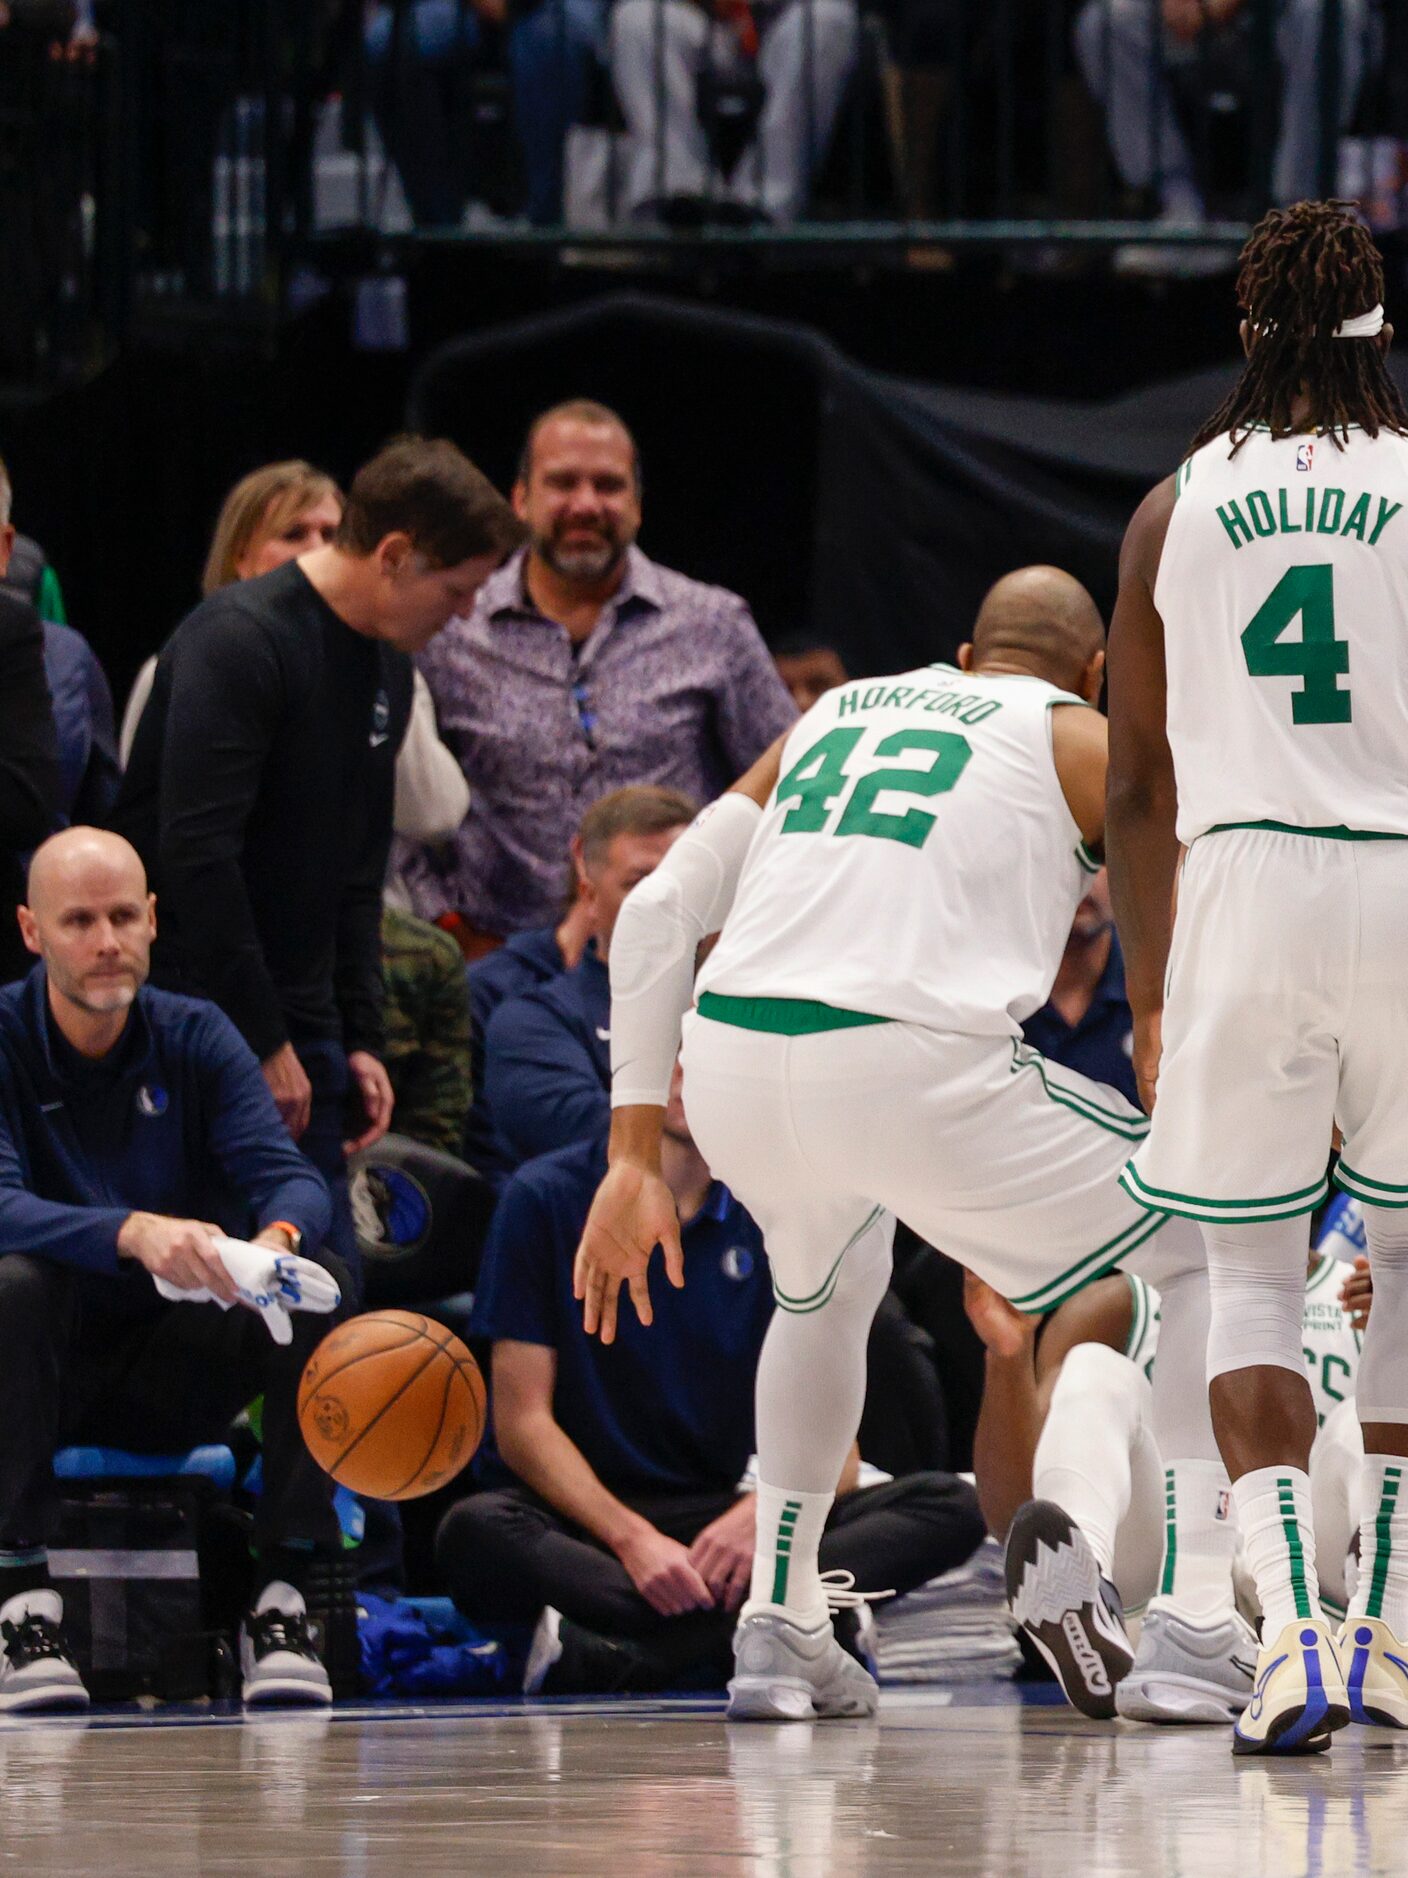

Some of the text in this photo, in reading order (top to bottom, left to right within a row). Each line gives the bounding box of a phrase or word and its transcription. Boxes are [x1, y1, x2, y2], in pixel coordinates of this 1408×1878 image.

[1215, 487, 1404, 550] HOLIDAY
[1239, 562, 1353, 726] 4
[837, 685, 1004, 727] HORFORD
[775, 726, 975, 850] 42
[1303, 1320, 1343, 1331] PRINT
[1304, 1303, 1342, 1319] VISTA
